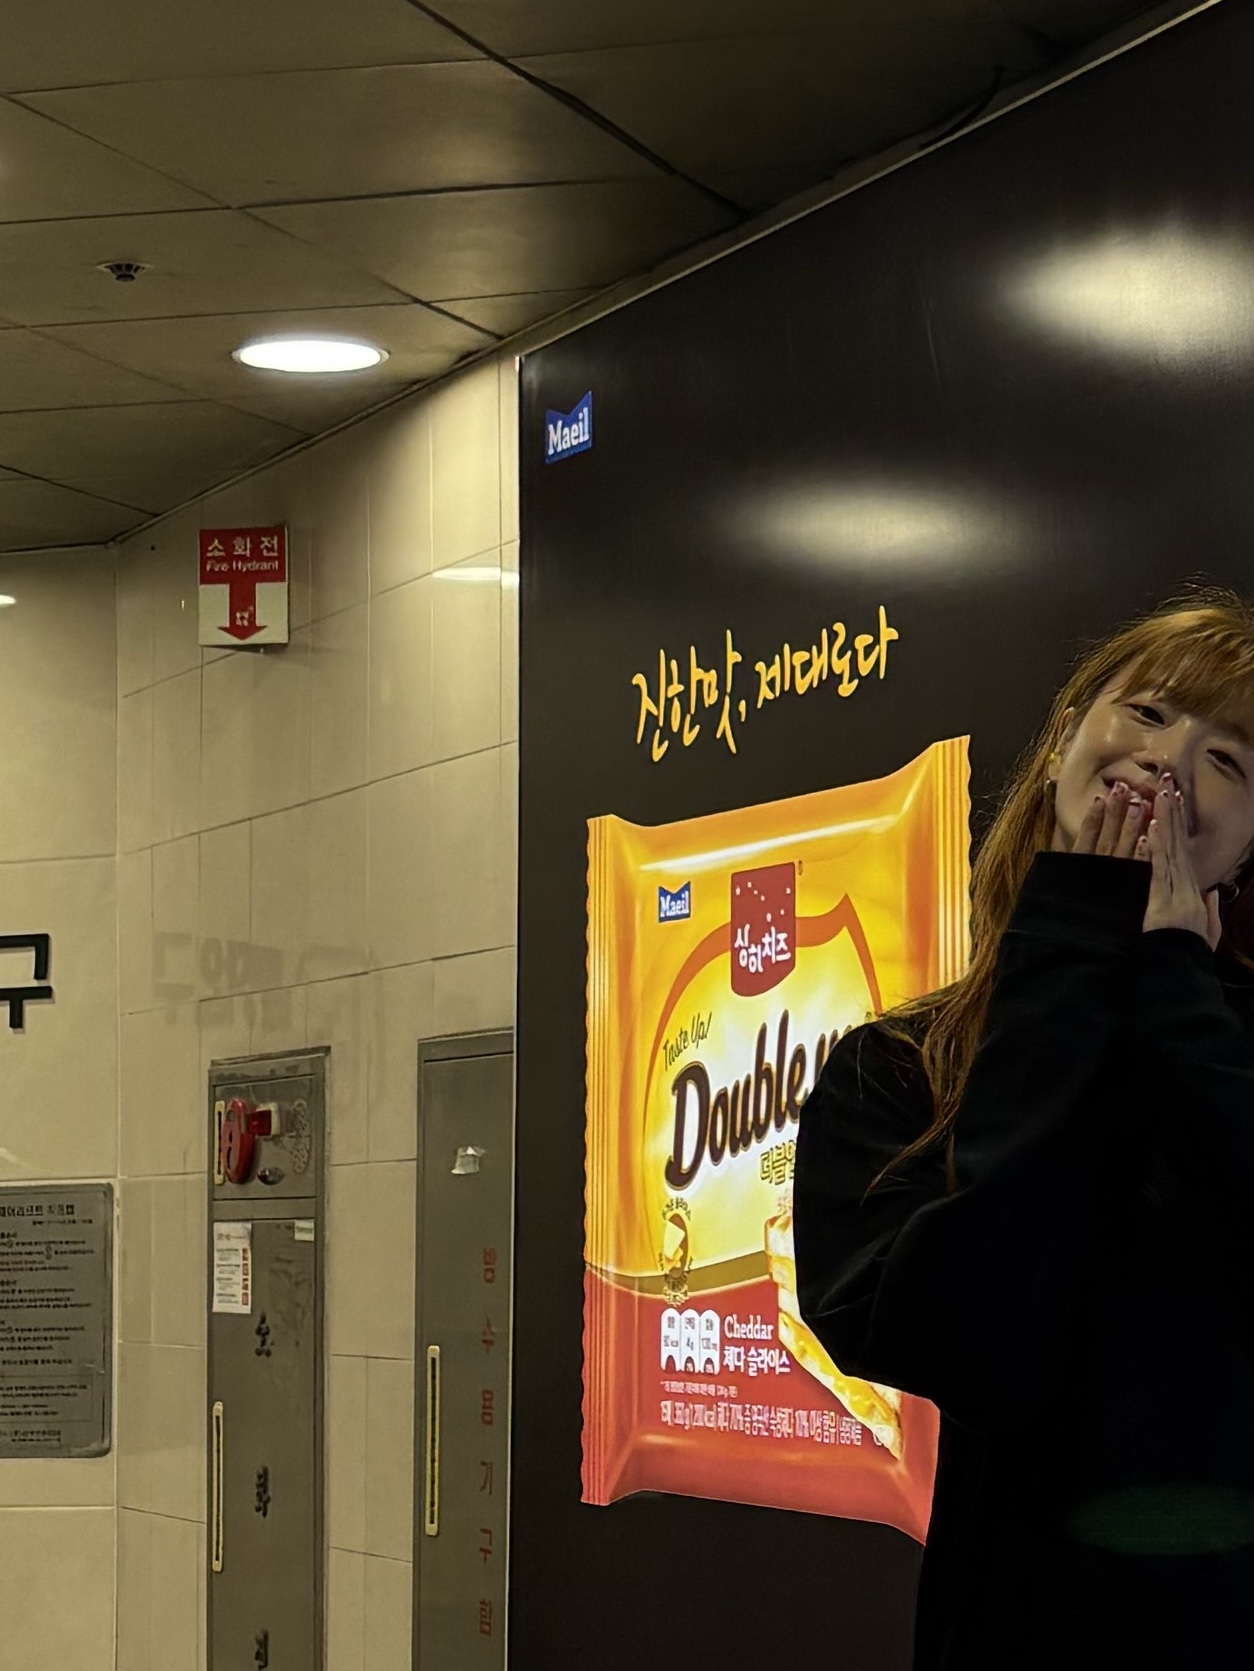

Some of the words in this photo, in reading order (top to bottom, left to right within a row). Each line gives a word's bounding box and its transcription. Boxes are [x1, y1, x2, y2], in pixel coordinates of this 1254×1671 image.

[547, 407, 590, 456] Maeil
[205, 535, 279, 558] 소화전
[659, 890, 690, 918] Maeil
[662, 1028, 690, 1072] Taste
[723, 1313, 774, 1340] Cheddar
[723, 1345, 746, 1373] 체다
[747, 1346, 791, 1377] 슬라이스
